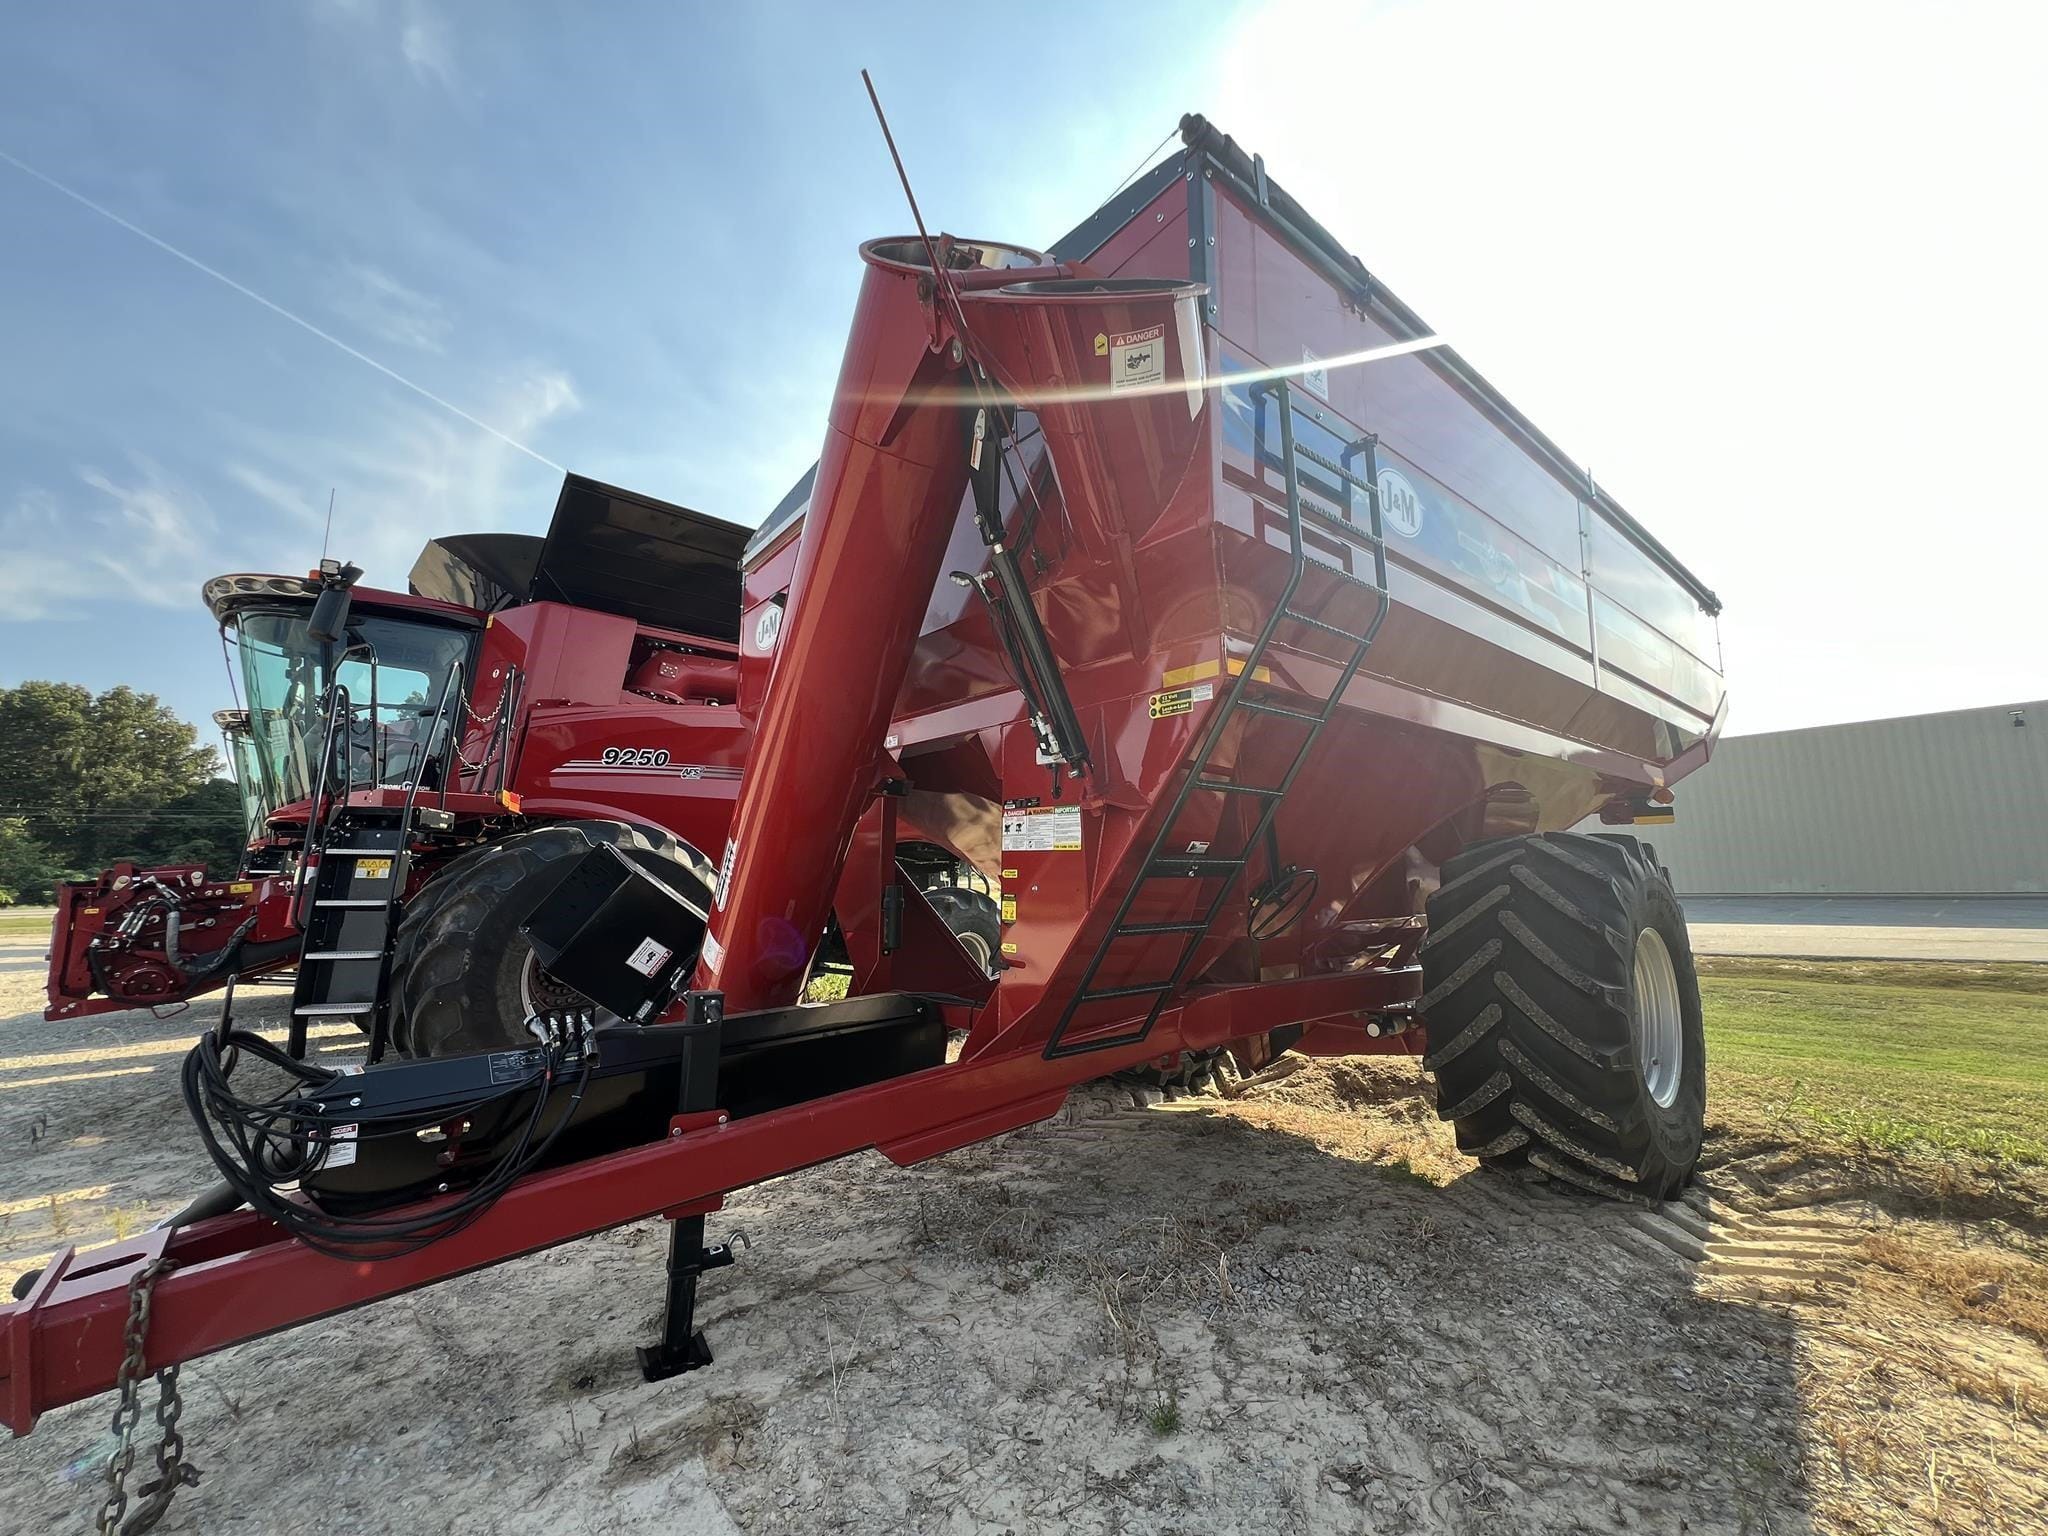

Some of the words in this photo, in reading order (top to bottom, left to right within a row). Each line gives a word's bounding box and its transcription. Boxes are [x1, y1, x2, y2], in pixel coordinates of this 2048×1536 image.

[1126, 328, 1159, 344] DANGER
[1379, 479, 1416, 528] J&M
[758, 612, 778, 644] J&M
[602, 748, 669, 767] 9250
[681, 768, 700, 776] AFS
